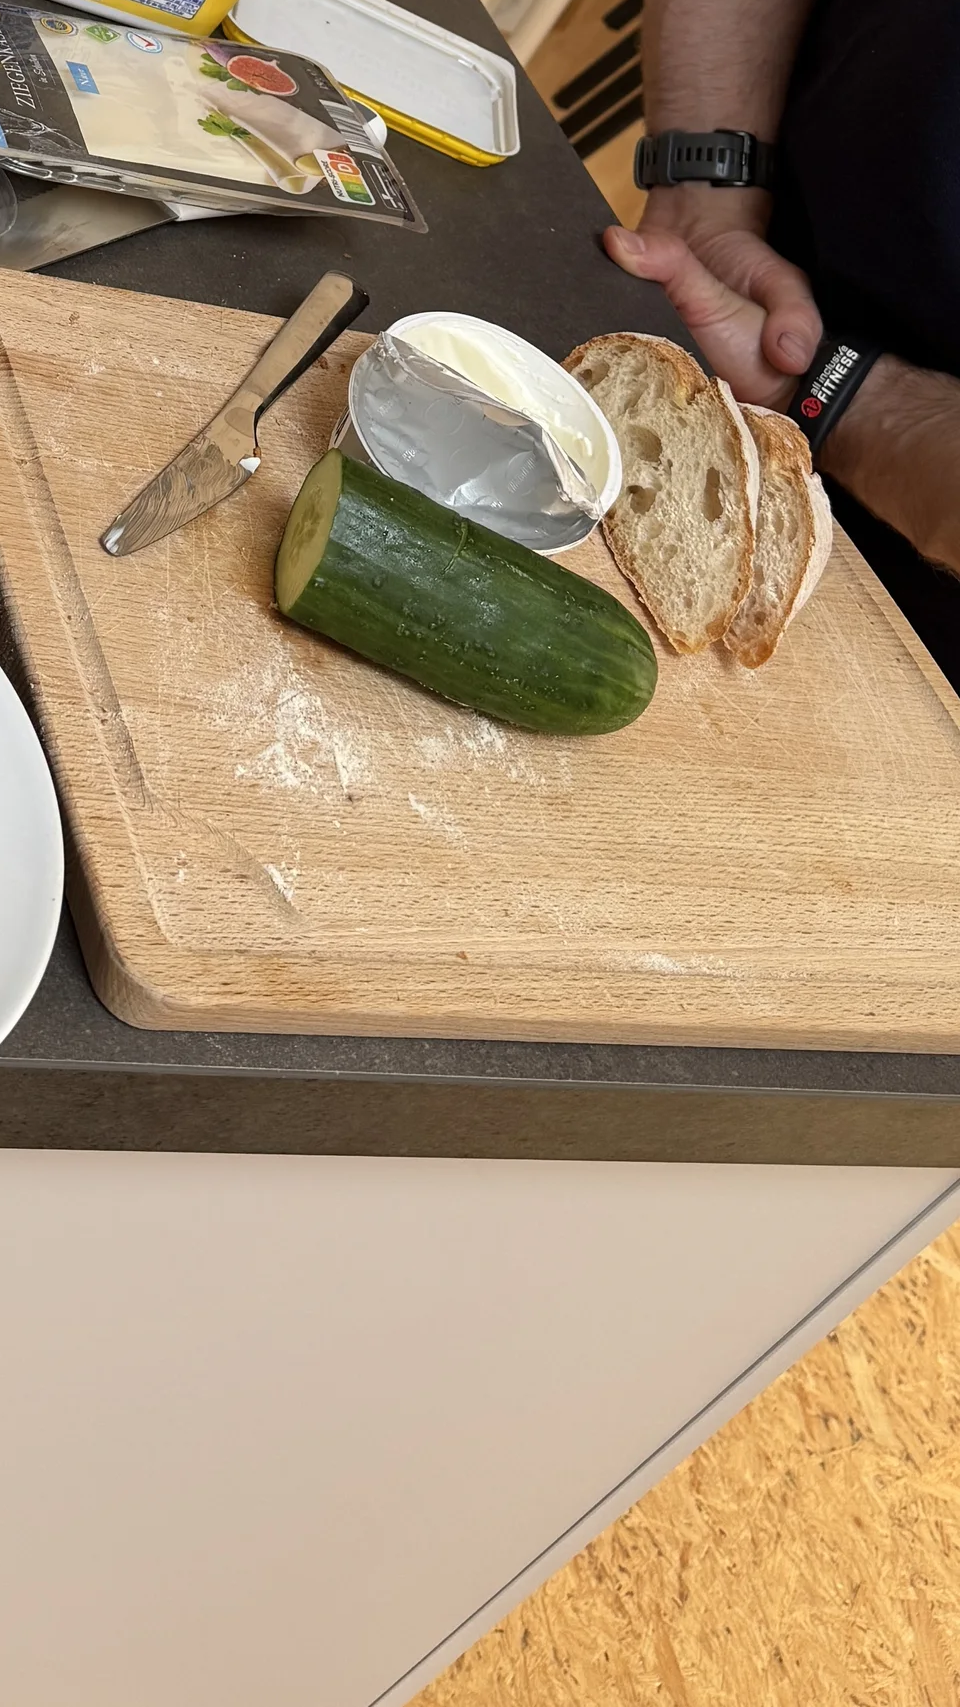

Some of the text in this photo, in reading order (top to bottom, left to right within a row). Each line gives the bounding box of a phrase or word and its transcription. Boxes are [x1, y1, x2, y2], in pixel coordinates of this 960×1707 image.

[321, 160, 344, 199] NUTRI-SCORE
[810, 344, 849, 397] all inclusive
[817, 349, 861, 404] FITNESS
